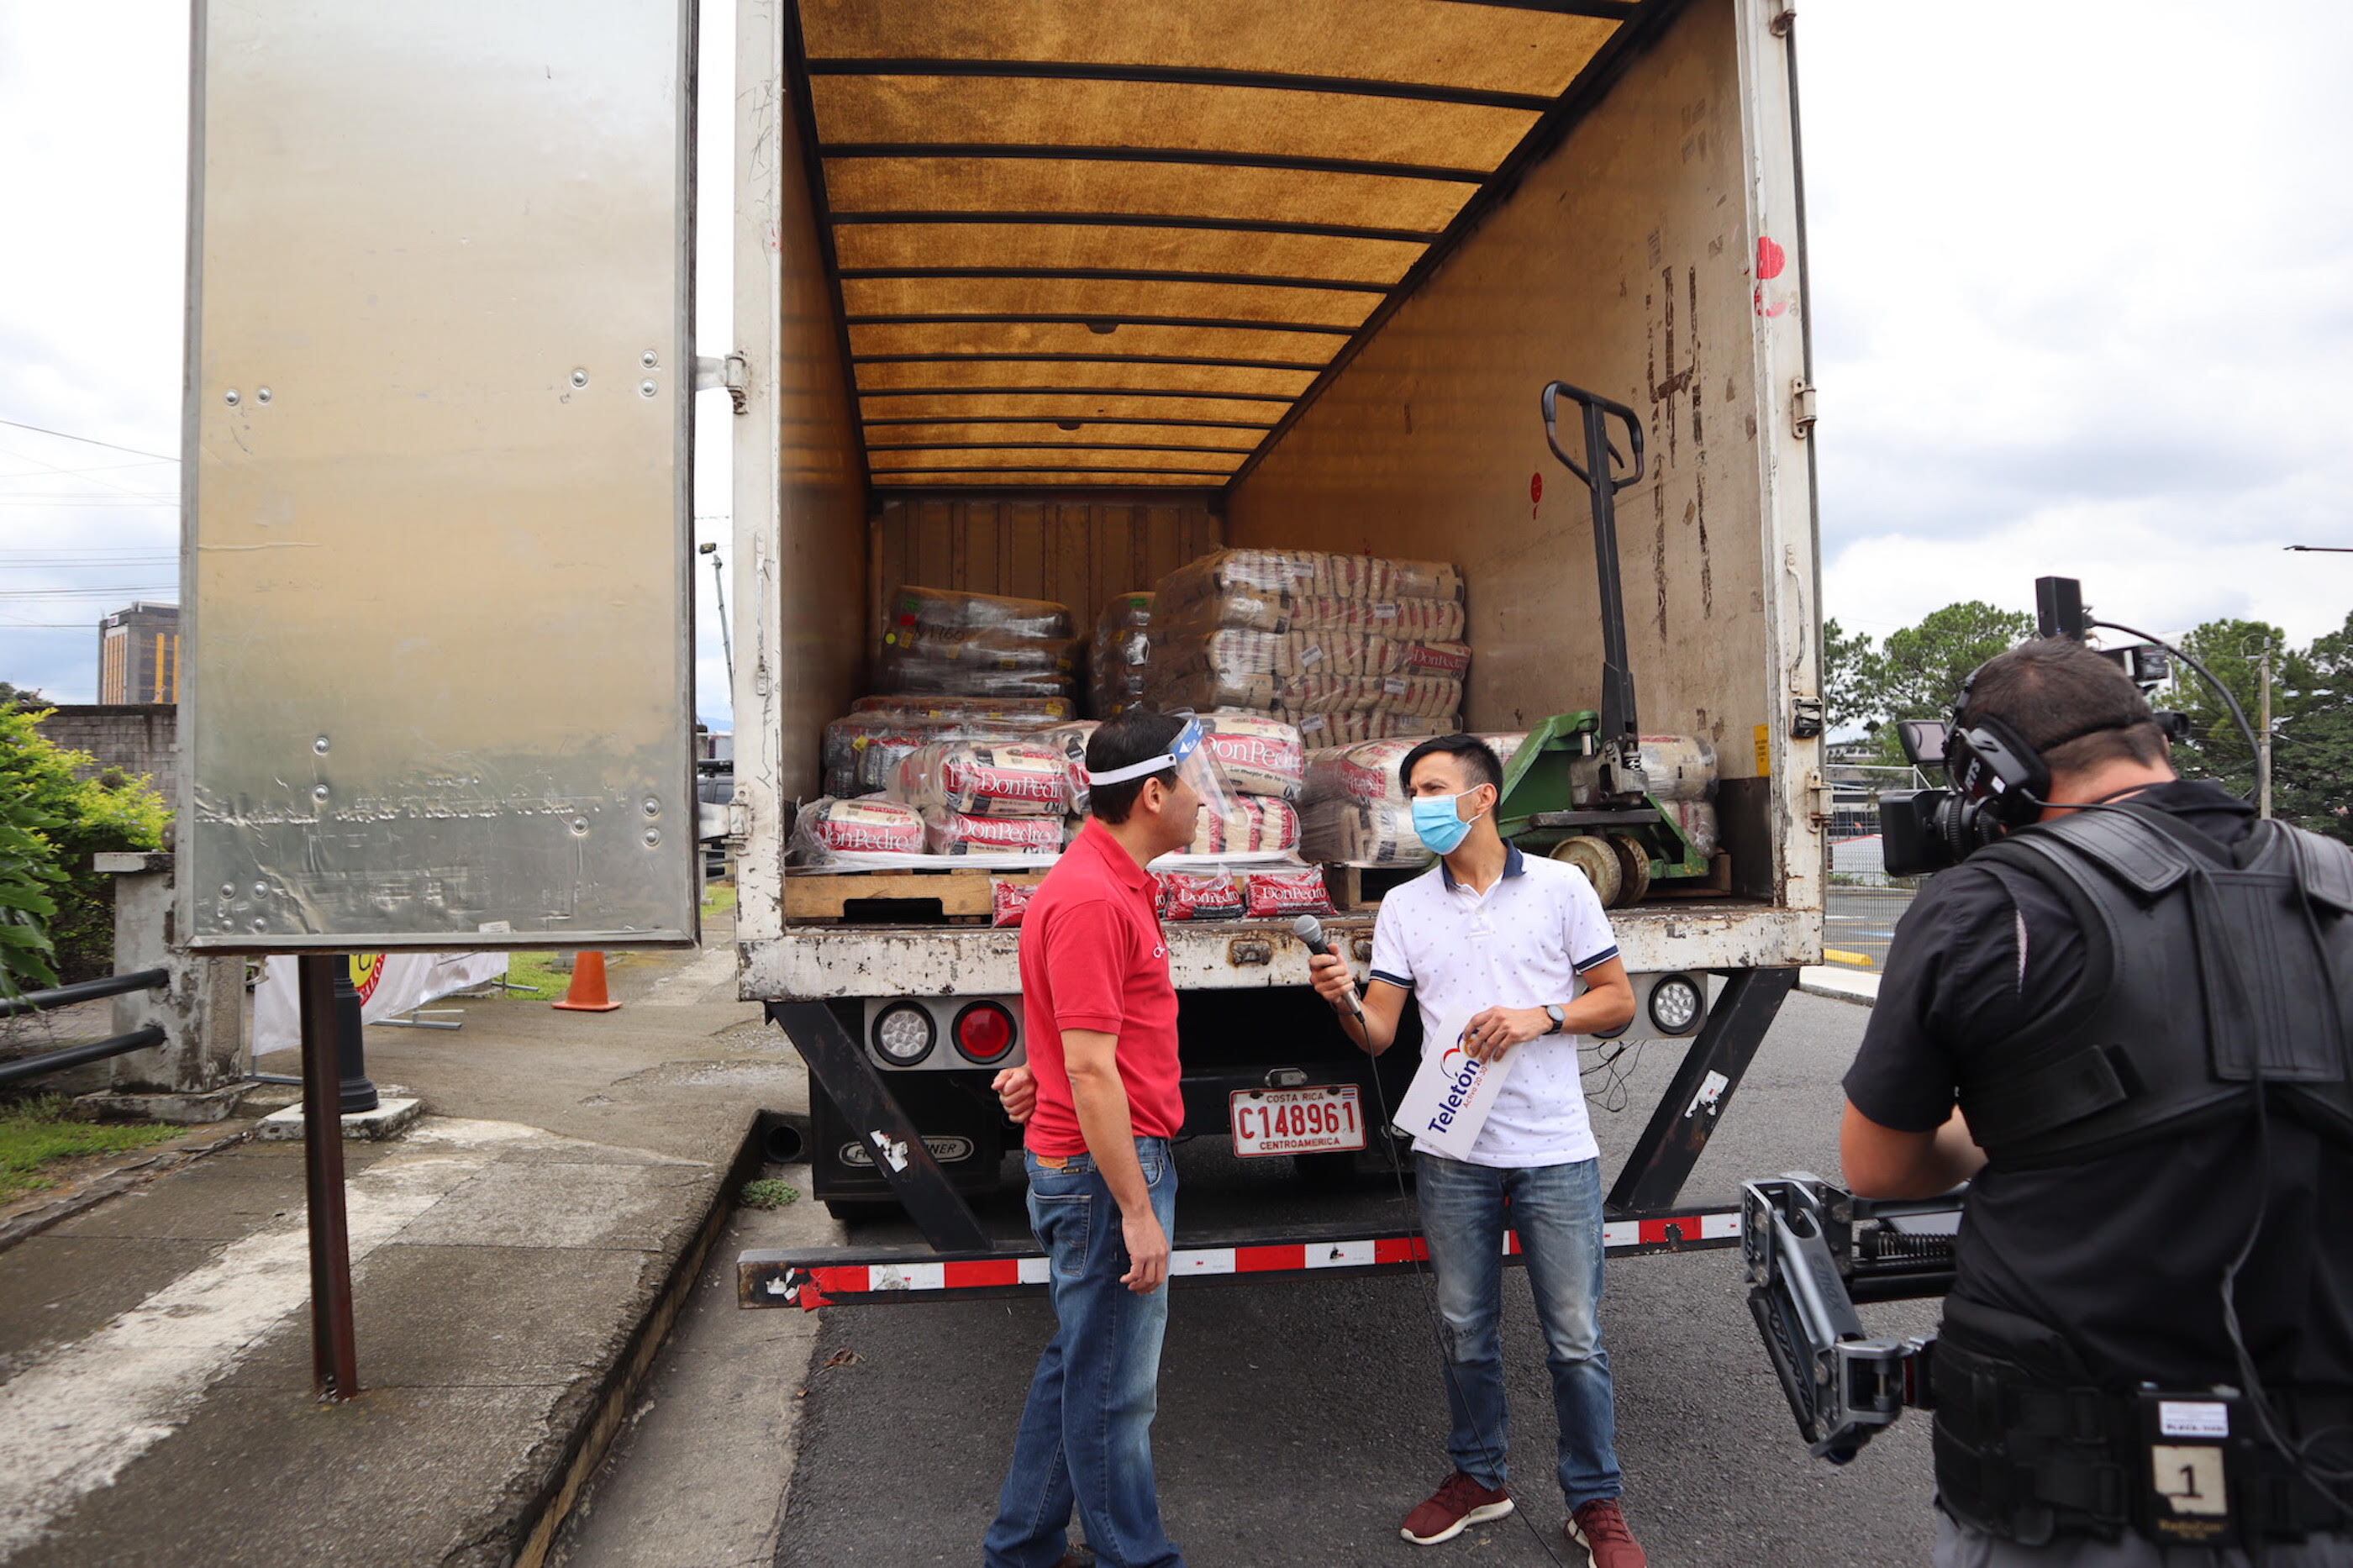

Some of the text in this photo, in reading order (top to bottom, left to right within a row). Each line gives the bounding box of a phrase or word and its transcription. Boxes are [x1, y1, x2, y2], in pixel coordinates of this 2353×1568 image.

[1413, 649, 1466, 670] DonPed
[1266, 1092, 1324, 1103] COSTA RICA
[1428, 1060, 1481, 1134] Teletón
[1239, 1102, 1355, 1139] C148961
[1260, 1137, 1341, 1150] CENTROAMERICA
[2178, 1463, 2205, 1499] 1
